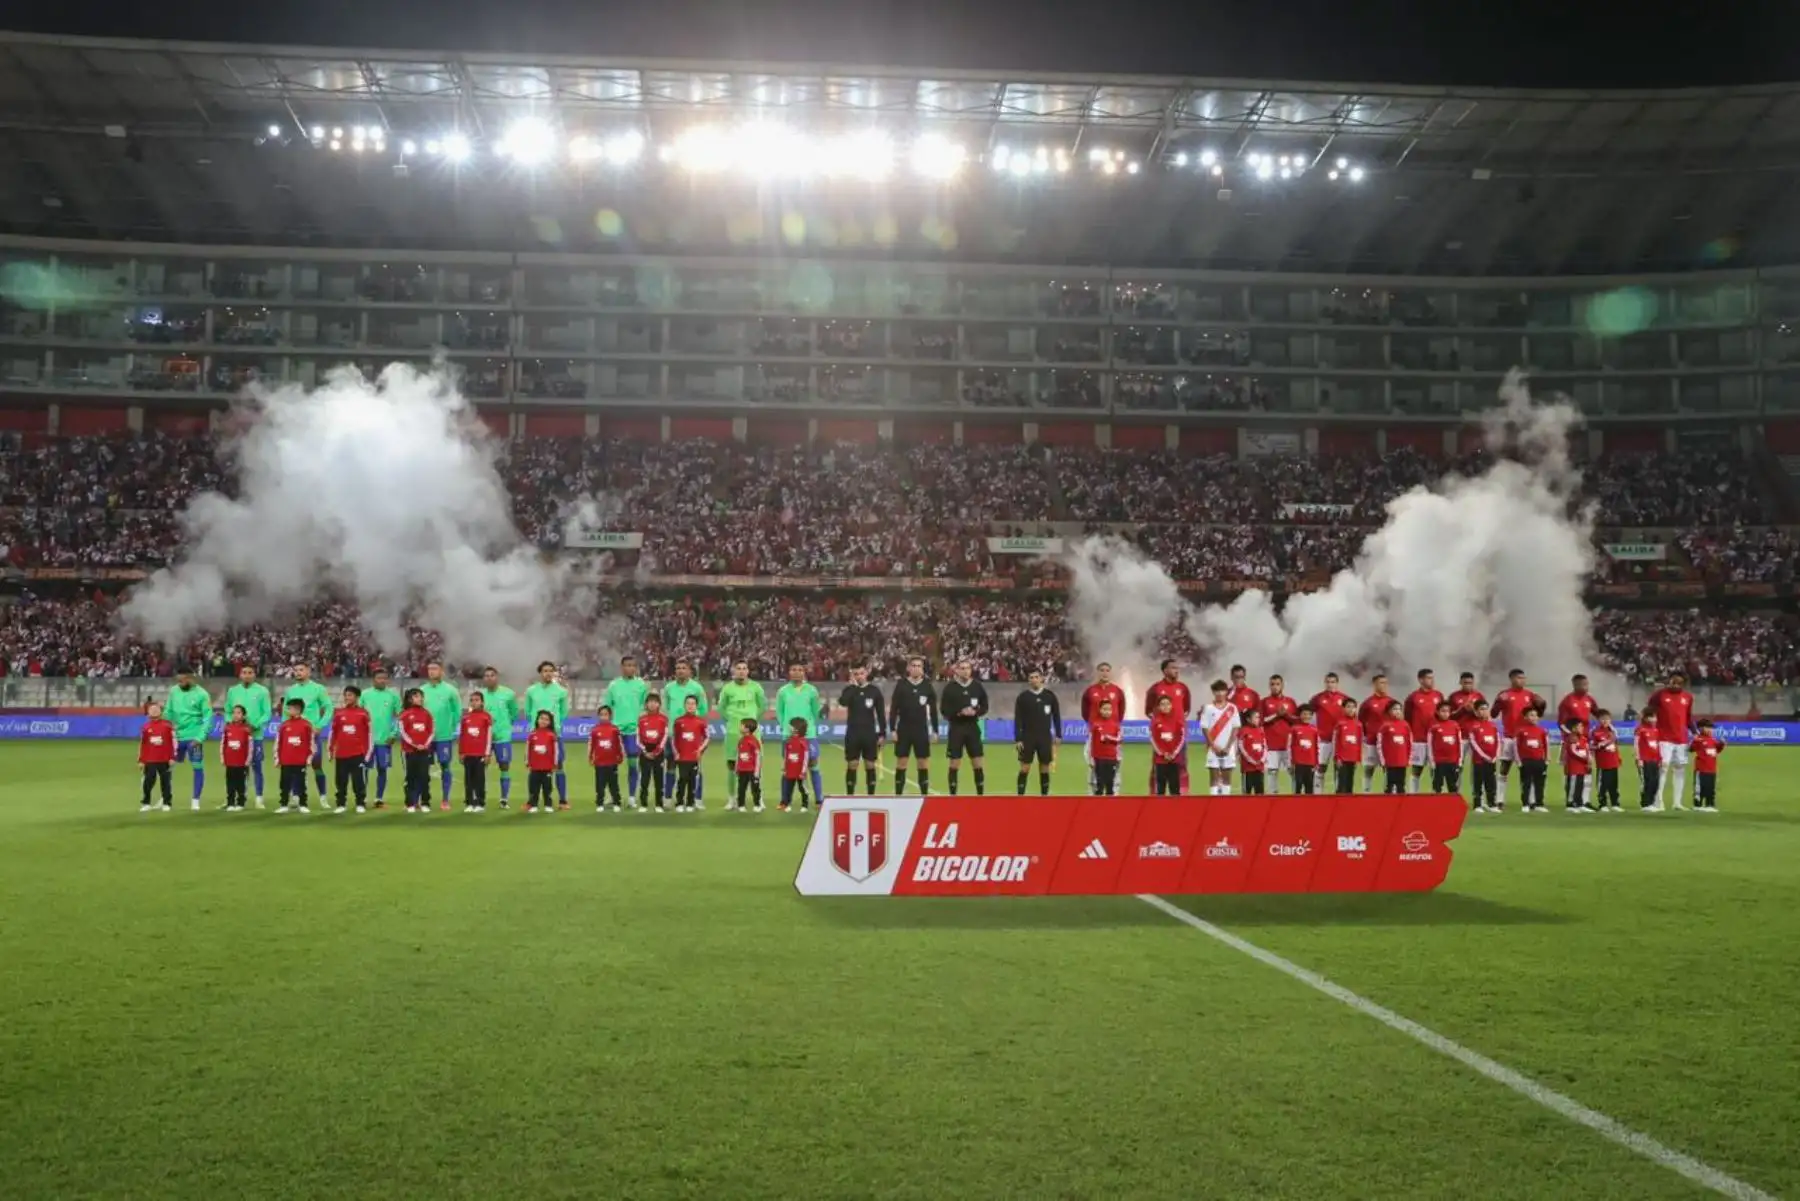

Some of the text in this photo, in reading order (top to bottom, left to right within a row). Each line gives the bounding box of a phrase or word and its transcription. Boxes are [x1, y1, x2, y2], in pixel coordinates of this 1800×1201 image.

[923, 823, 958, 849] LA
[1337, 836, 1367, 851] BIG
[1206, 847, 1239, 857] CRISTAL
[1269, 844, 1306, 856] Claro
[912, 855, 1030, 882] BICOLOR
